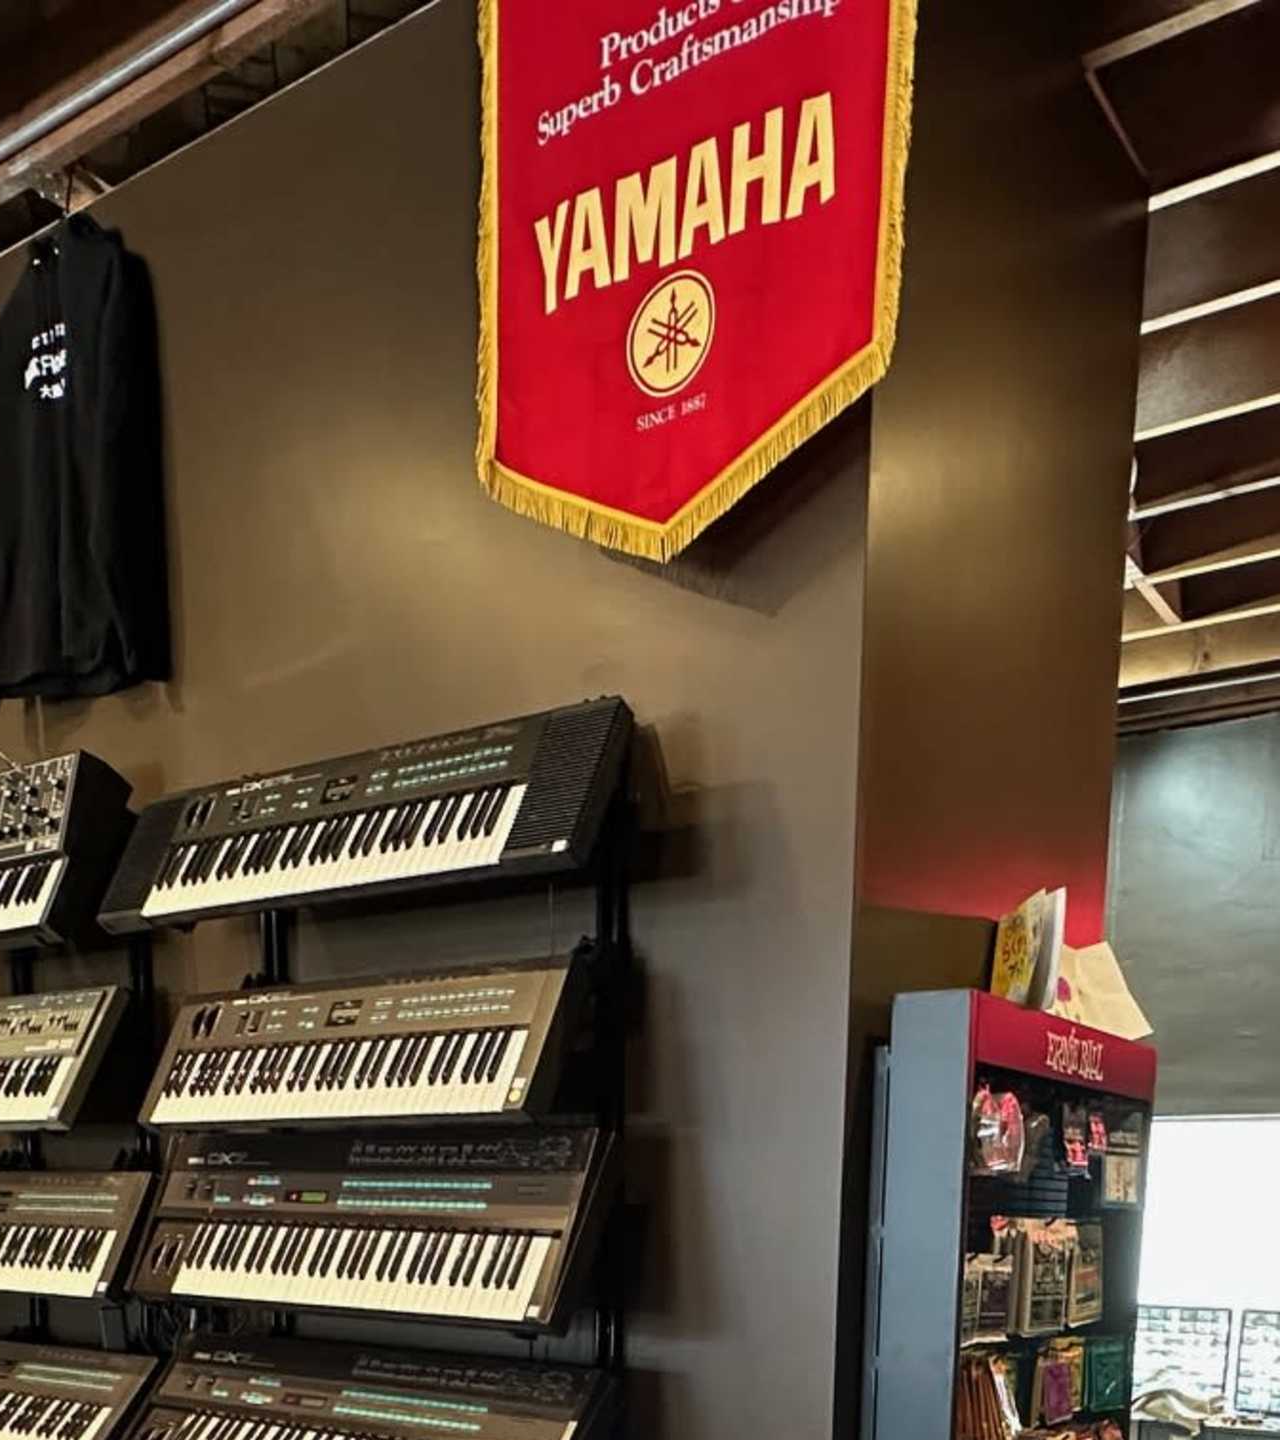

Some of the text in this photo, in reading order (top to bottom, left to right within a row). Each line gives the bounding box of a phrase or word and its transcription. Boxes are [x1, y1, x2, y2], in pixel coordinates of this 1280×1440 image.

[601, 0, 720, 69] Products
[537, 74, 622, 147] Superb
[533, 90, 837, 316] YAMAHA
[635, 392, 707, 432] SINCE 1887
[1045, 1027, 1105, 1082] ERNIE BALL
